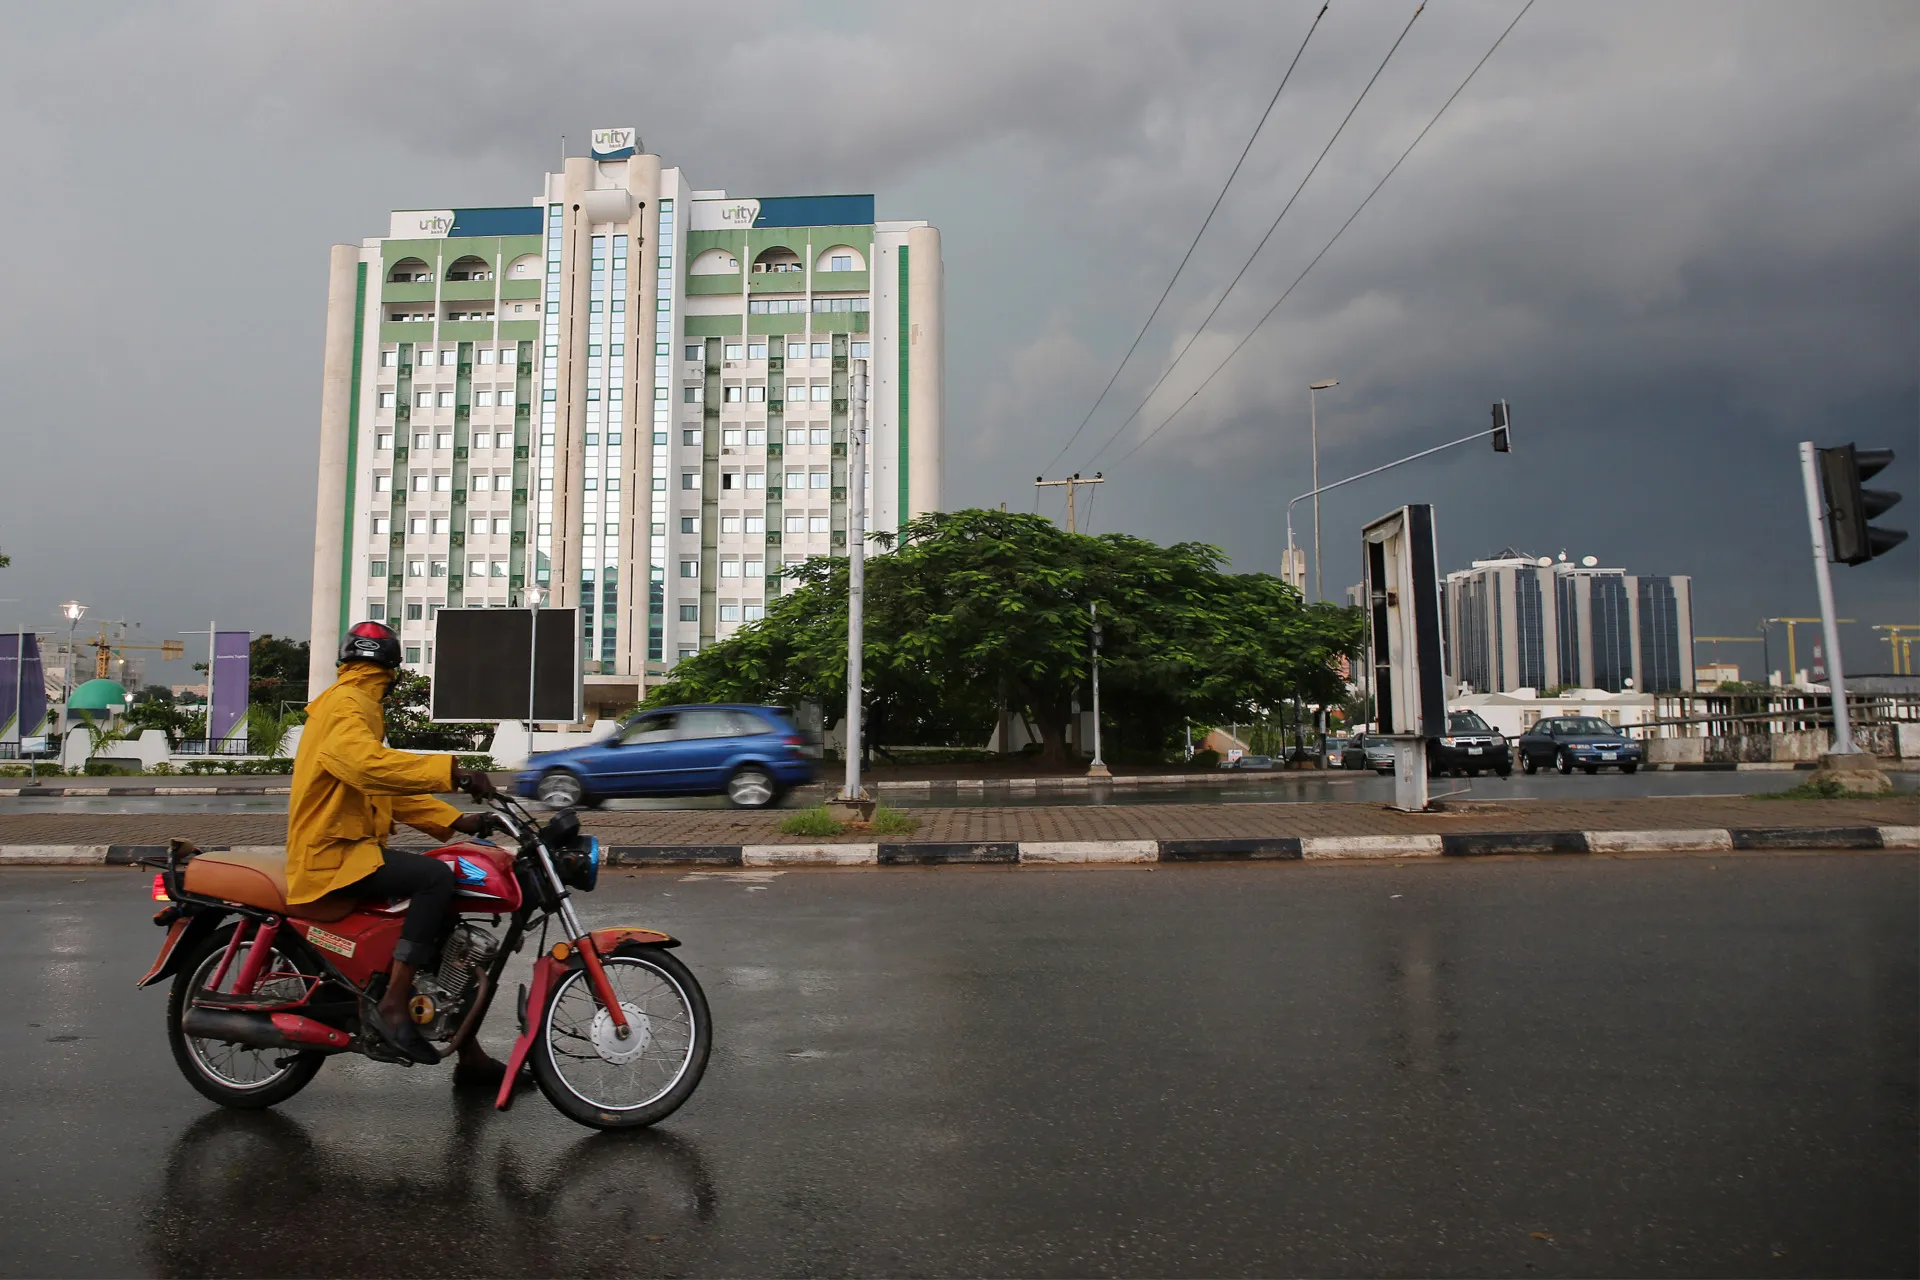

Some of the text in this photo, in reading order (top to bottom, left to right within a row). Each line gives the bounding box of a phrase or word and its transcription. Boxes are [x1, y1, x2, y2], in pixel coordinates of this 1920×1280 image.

[595, 129, 630, 147] unity
[722, 205, 757, 223] unity
[420, 216, 452, 233] unity
